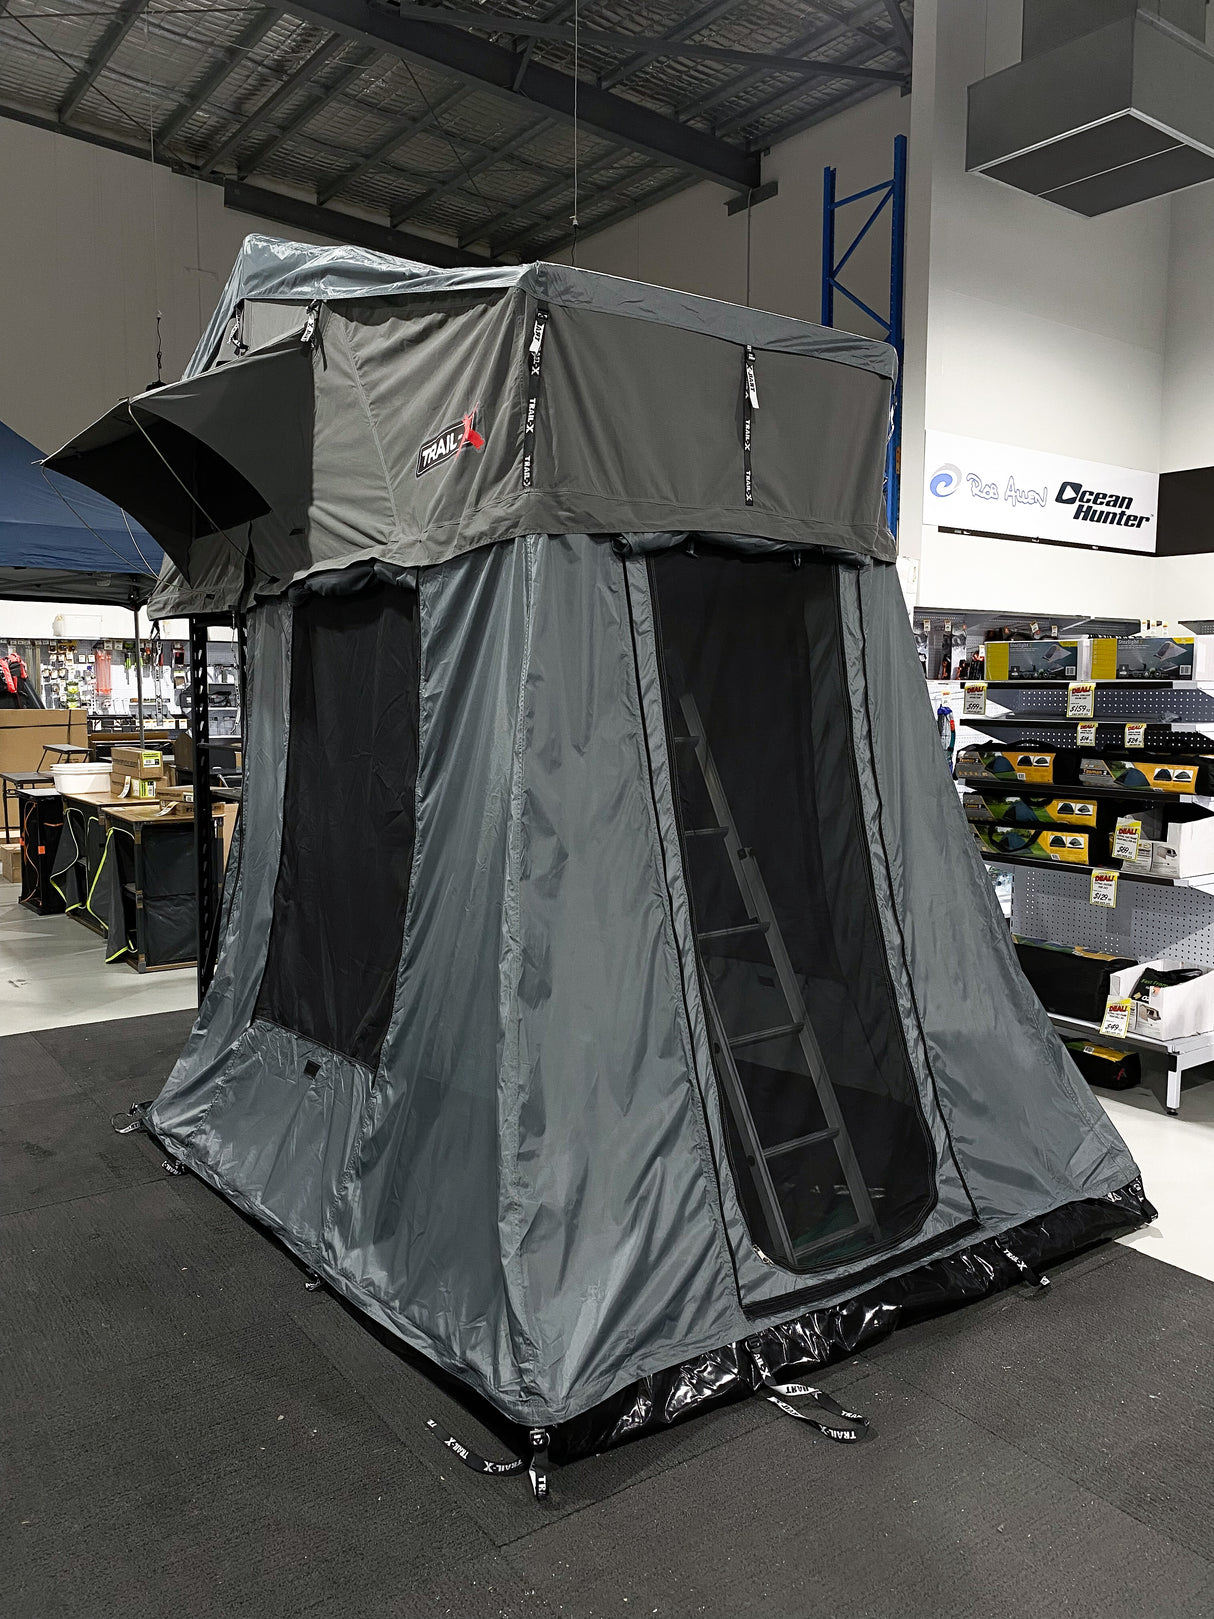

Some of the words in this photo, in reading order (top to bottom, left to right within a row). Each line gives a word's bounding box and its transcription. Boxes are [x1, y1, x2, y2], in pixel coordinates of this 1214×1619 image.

[526, 397, 537, 434] TRAIL-X
[744, 419, 752, 452] TRAIL-X
[745, 470, 753, 501] TRAIL-X
[1055, 481, 1134, 510] Ocean
[1073, 504, 1151, 528] Hunter
[1072, 685, 1092, 694] DEAL!
[1070, 704, 1087, 712] $159
[1093, 892, 1109, 900] $129
[1105, 1023, 1119, 1031] $49
[1003, 1249, 1028, 1271] TRAIL-X
[819, 1424, 856, 1439] TRAIL-X
[444, 1436, 469, 1460] TRAIL-X
[484, 1459, 523, 1473] TRAIL-X
